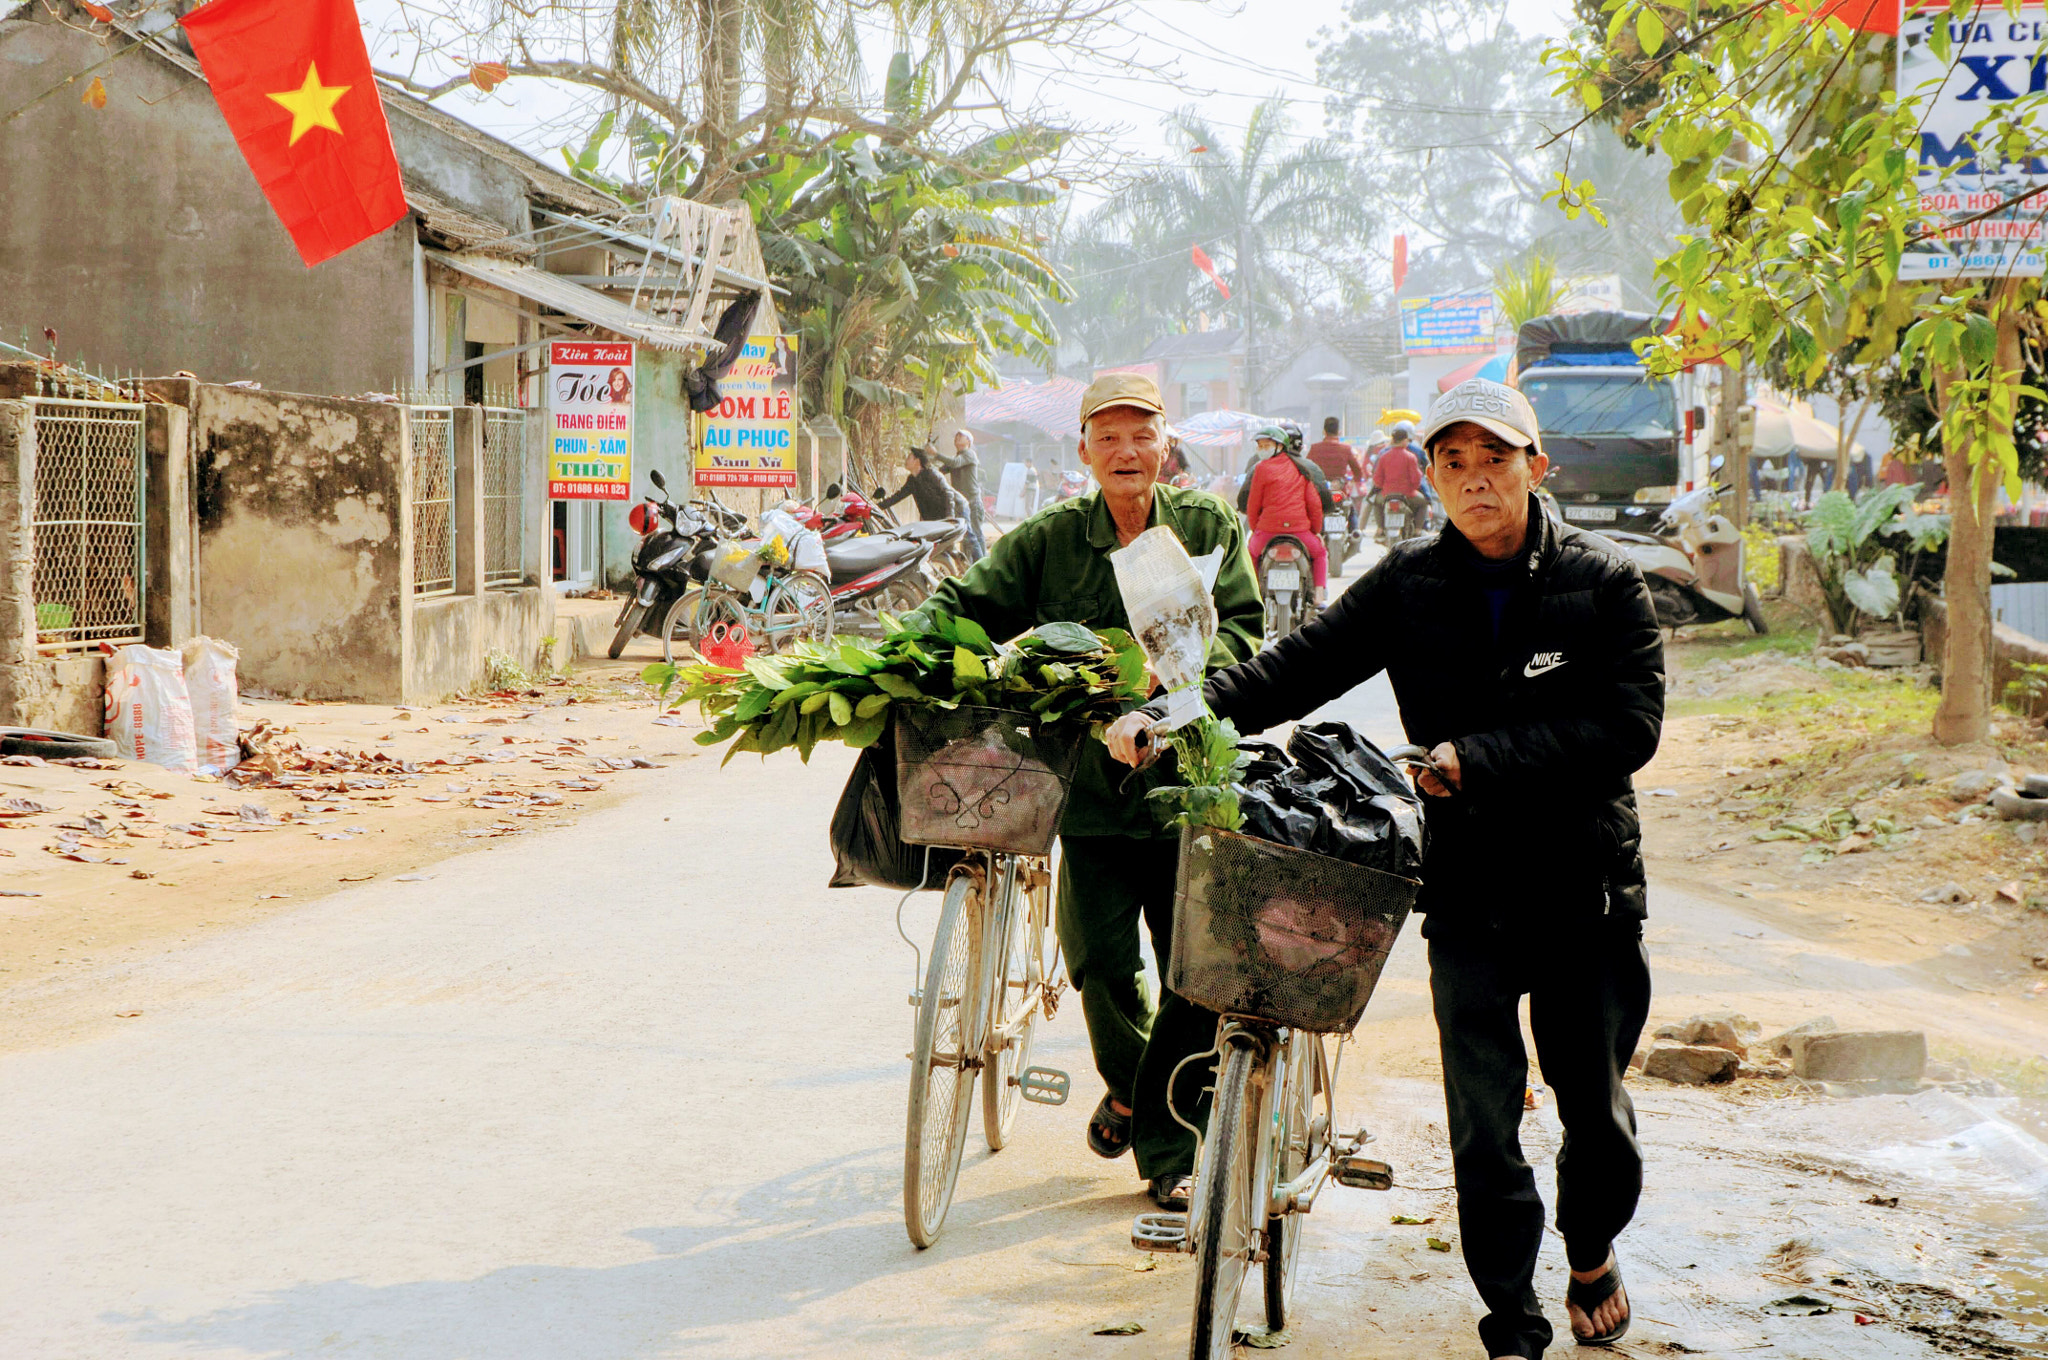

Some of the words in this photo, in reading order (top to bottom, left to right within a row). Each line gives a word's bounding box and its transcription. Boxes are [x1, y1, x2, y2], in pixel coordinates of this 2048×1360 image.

[1970, 222, 2040, 238] KHUNG
[556, 347, 588, 360] Kiên
[593, 349, 628, 360] Hoài
[556, 372, 612, 404] Tóc
[746, 381, 767, 392] May
[762, 389, 791, 419] LÊ
[556, 414, 593, 429] TRANG
[597, 408, 626, 430] ĐIỂM
[555, 438, 587, 453] PHUN
[599, 436, 626, 455] XĂM
[705, 424, 731, 447] ÂU
[738, 429, 789, 452] PHỤC
[556, 459, 622, 478] THÊU
[712, 456, 750, 467] Nam
[1531, 652, 1562, 666] NIKE
